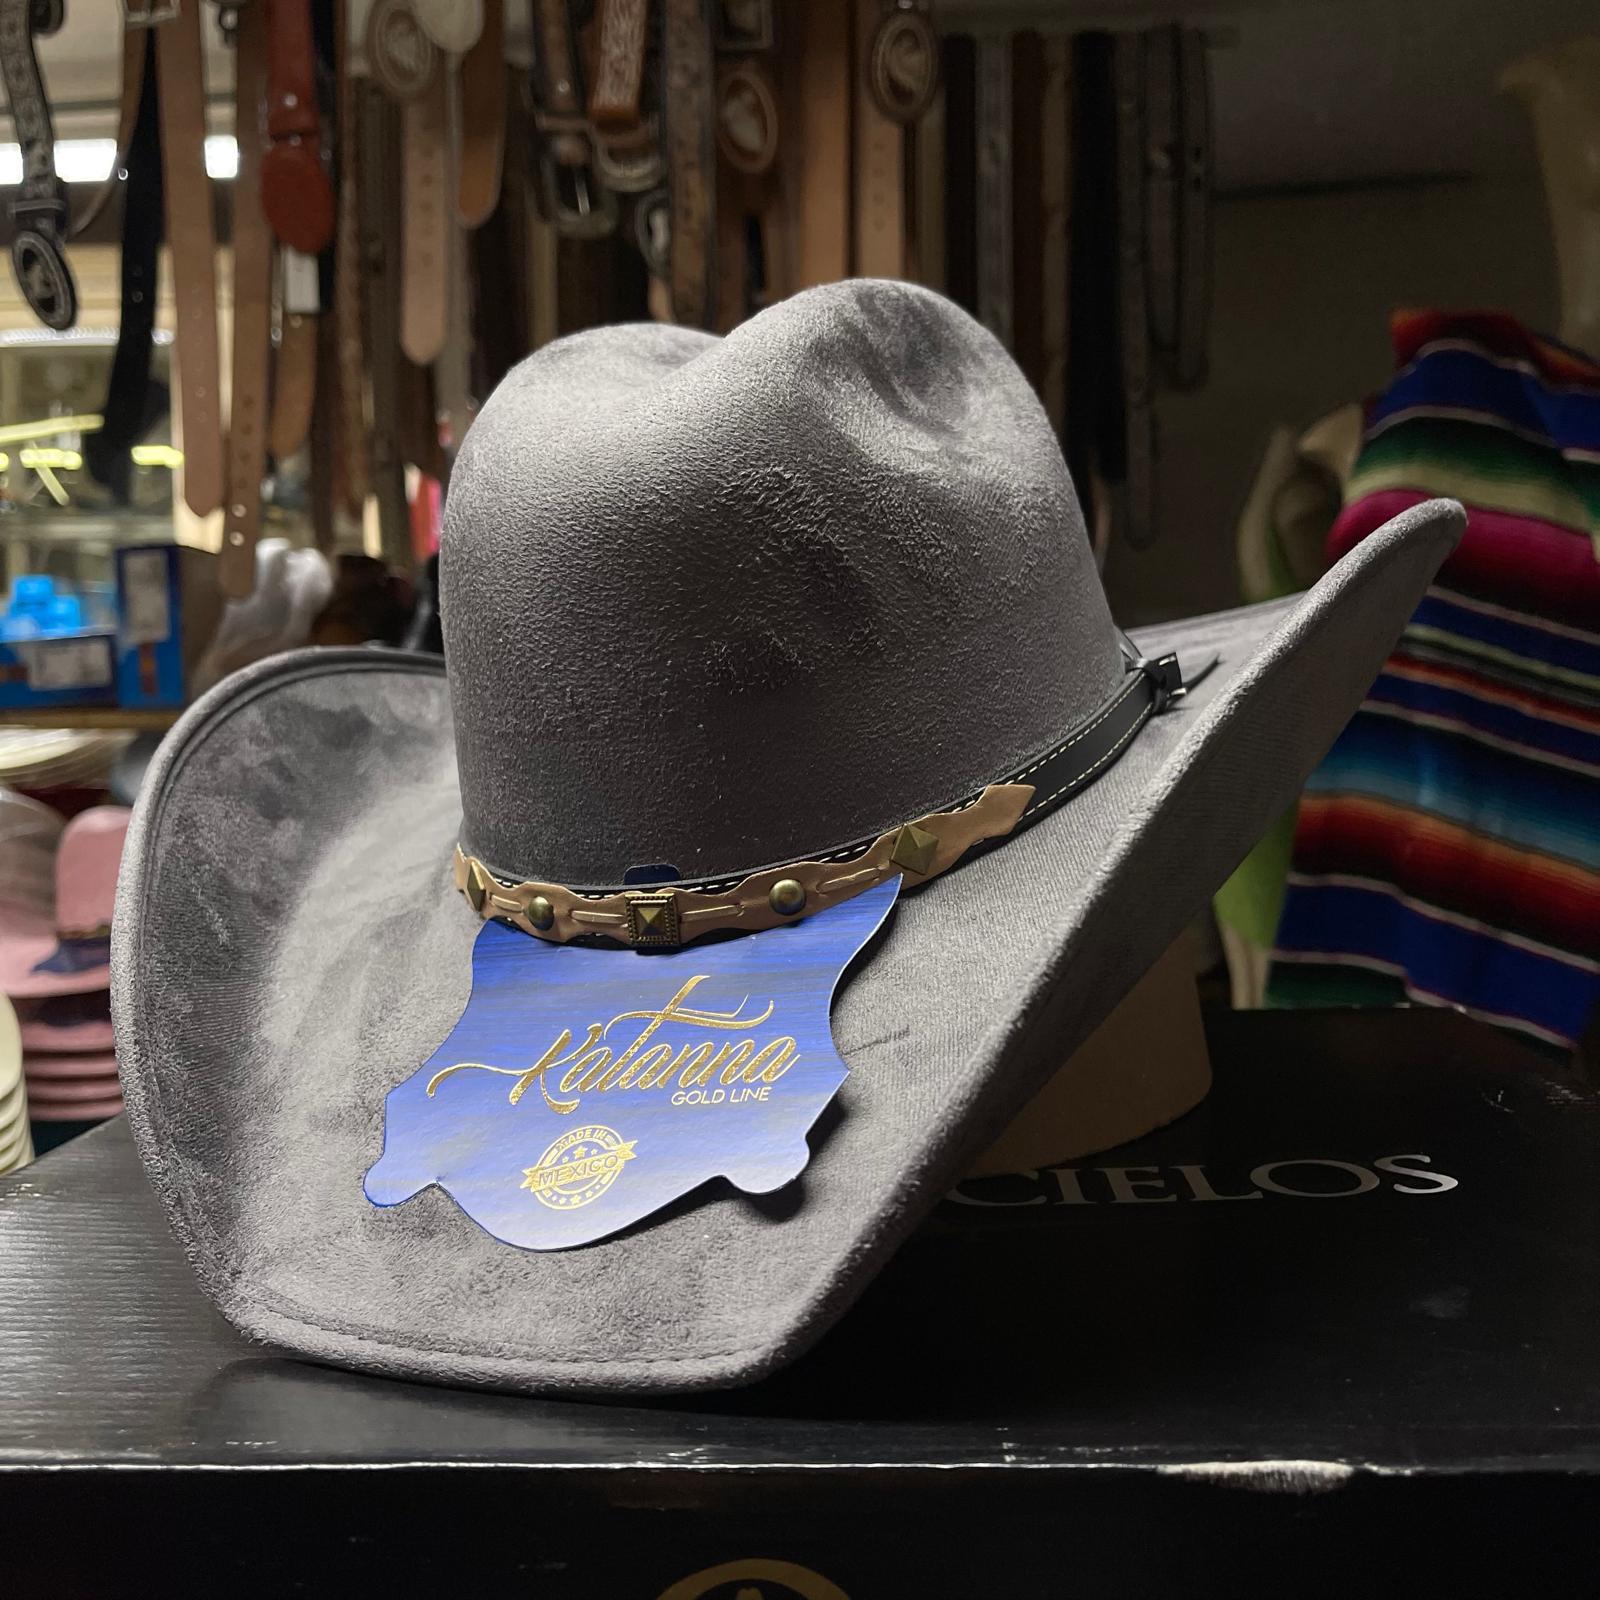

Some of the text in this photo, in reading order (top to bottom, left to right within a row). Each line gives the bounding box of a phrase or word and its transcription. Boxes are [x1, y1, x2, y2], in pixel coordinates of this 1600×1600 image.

[427, 975, 800, 1114] Katanna
[671, 1086, 772, 1106] GOLD LINE
[557, 1129, 608, 1150] MADE IN
[539, 1154, 618, 1187] MEXICO
[946, 1154, 1459, 1206] CIELOS
